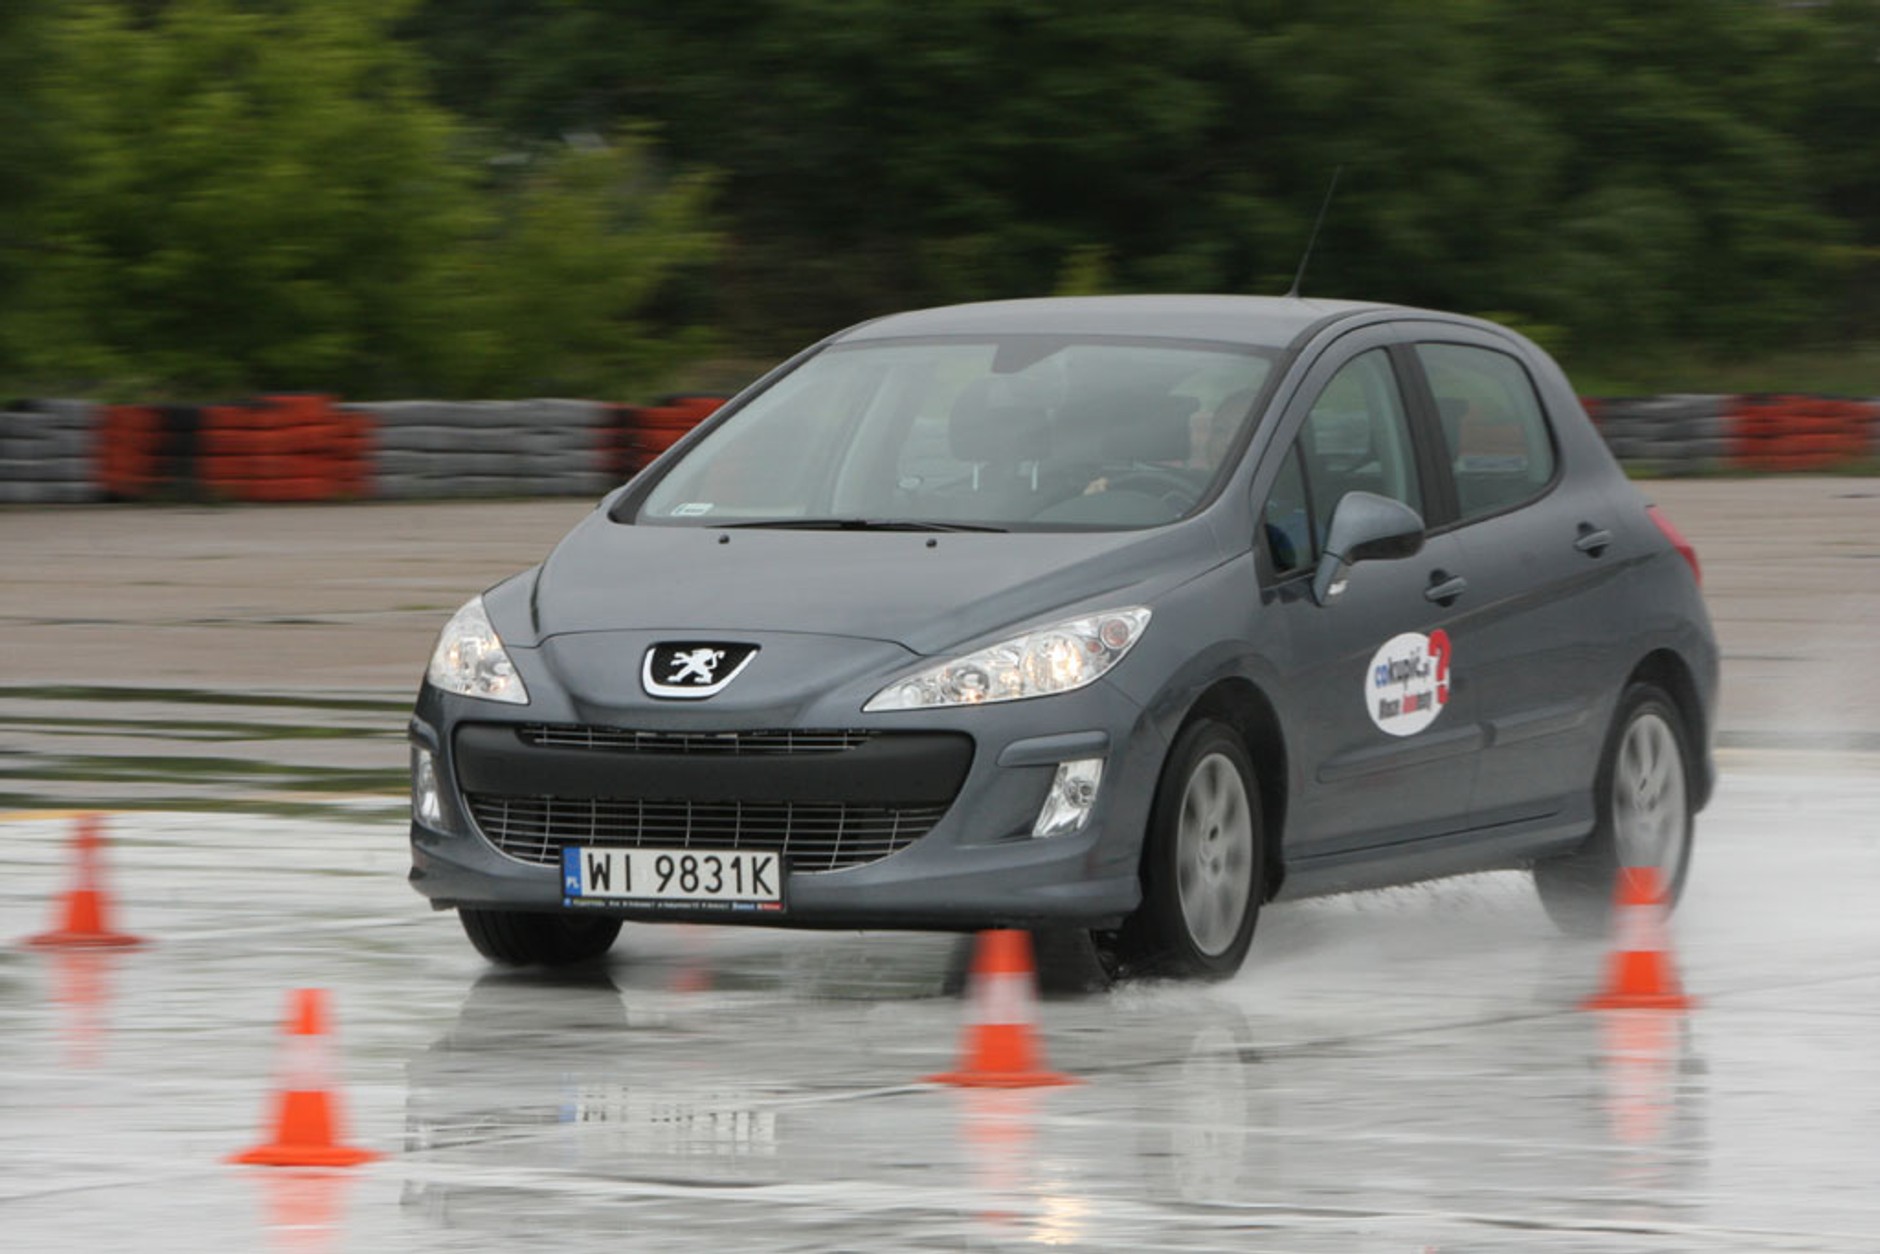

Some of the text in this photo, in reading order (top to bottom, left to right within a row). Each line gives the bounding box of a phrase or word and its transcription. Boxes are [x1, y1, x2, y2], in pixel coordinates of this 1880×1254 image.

[566, 877, 580, 889] PL
[587, 853, 773, 895] WI 9831K
